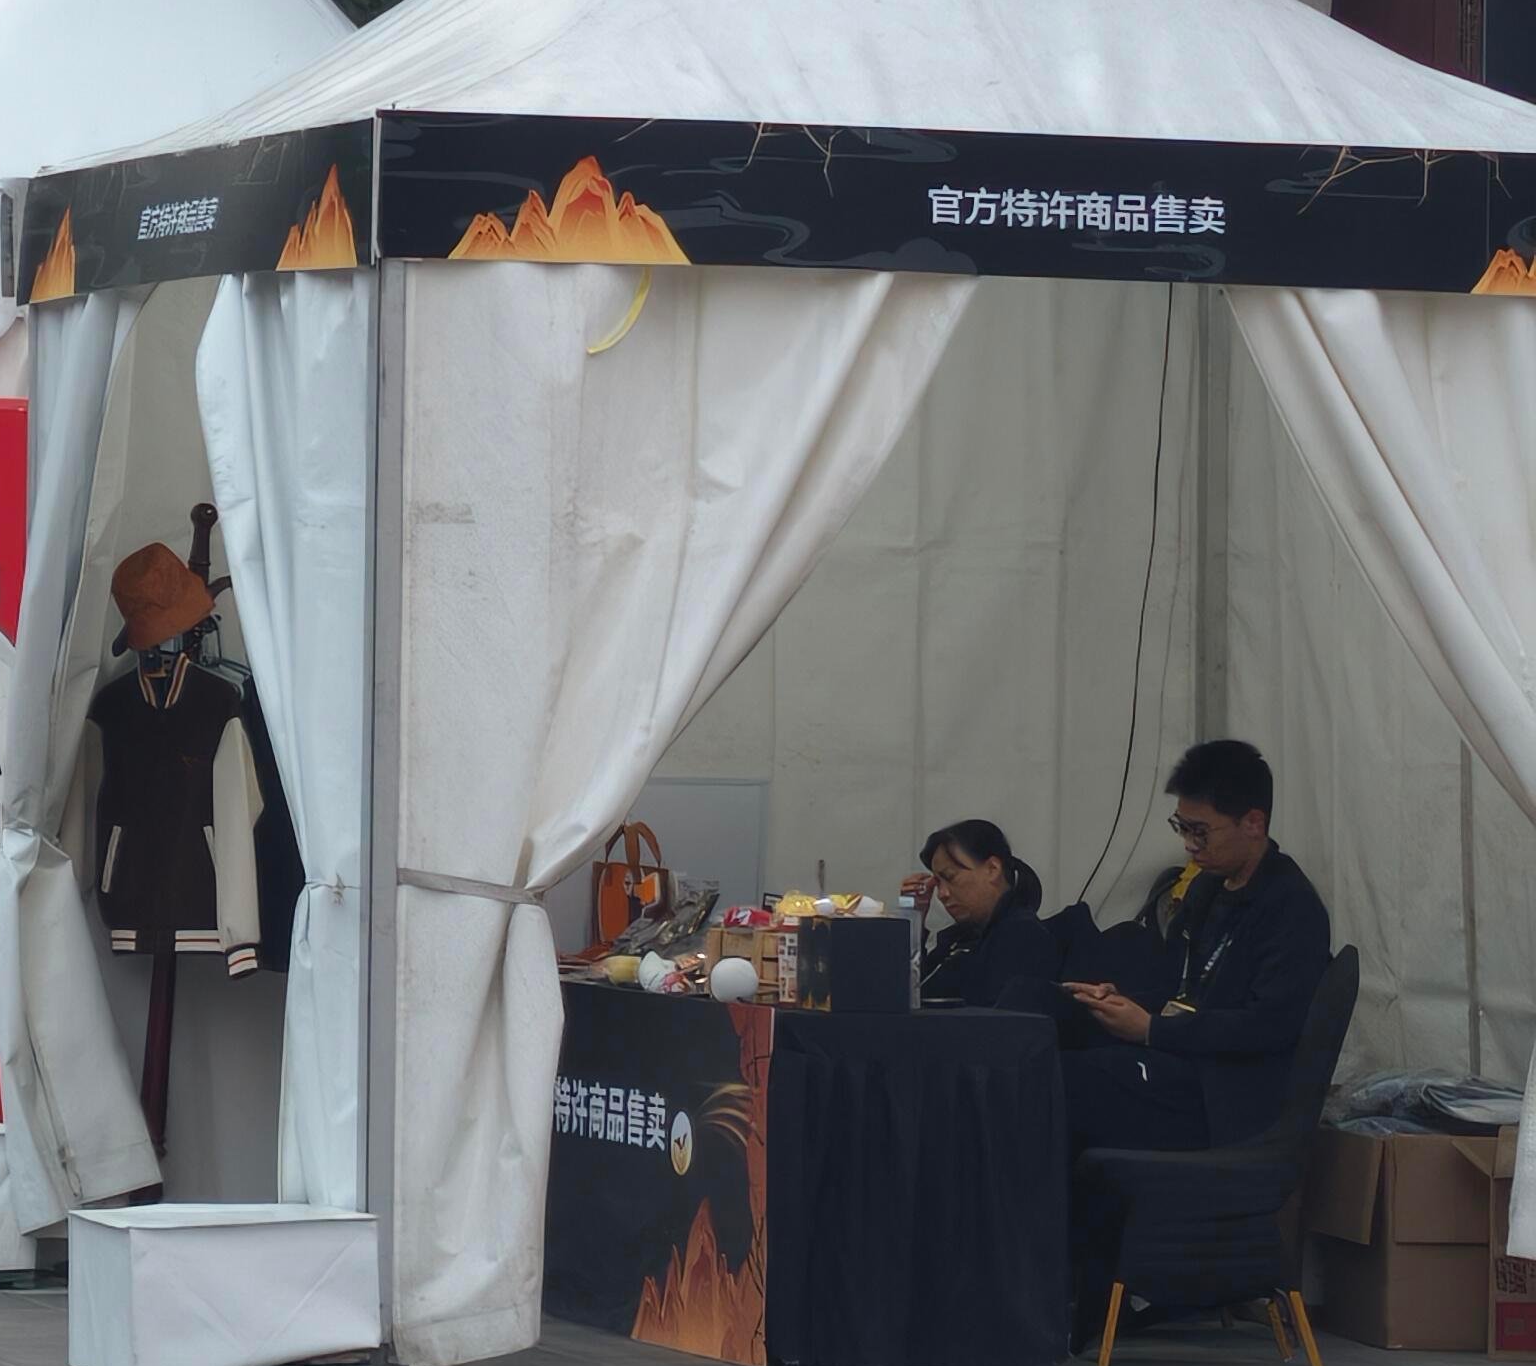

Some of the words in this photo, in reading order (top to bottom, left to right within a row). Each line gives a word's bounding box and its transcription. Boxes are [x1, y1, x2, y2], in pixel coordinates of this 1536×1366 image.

[927, 185, 1226, 234] 官方特许商品售卖
